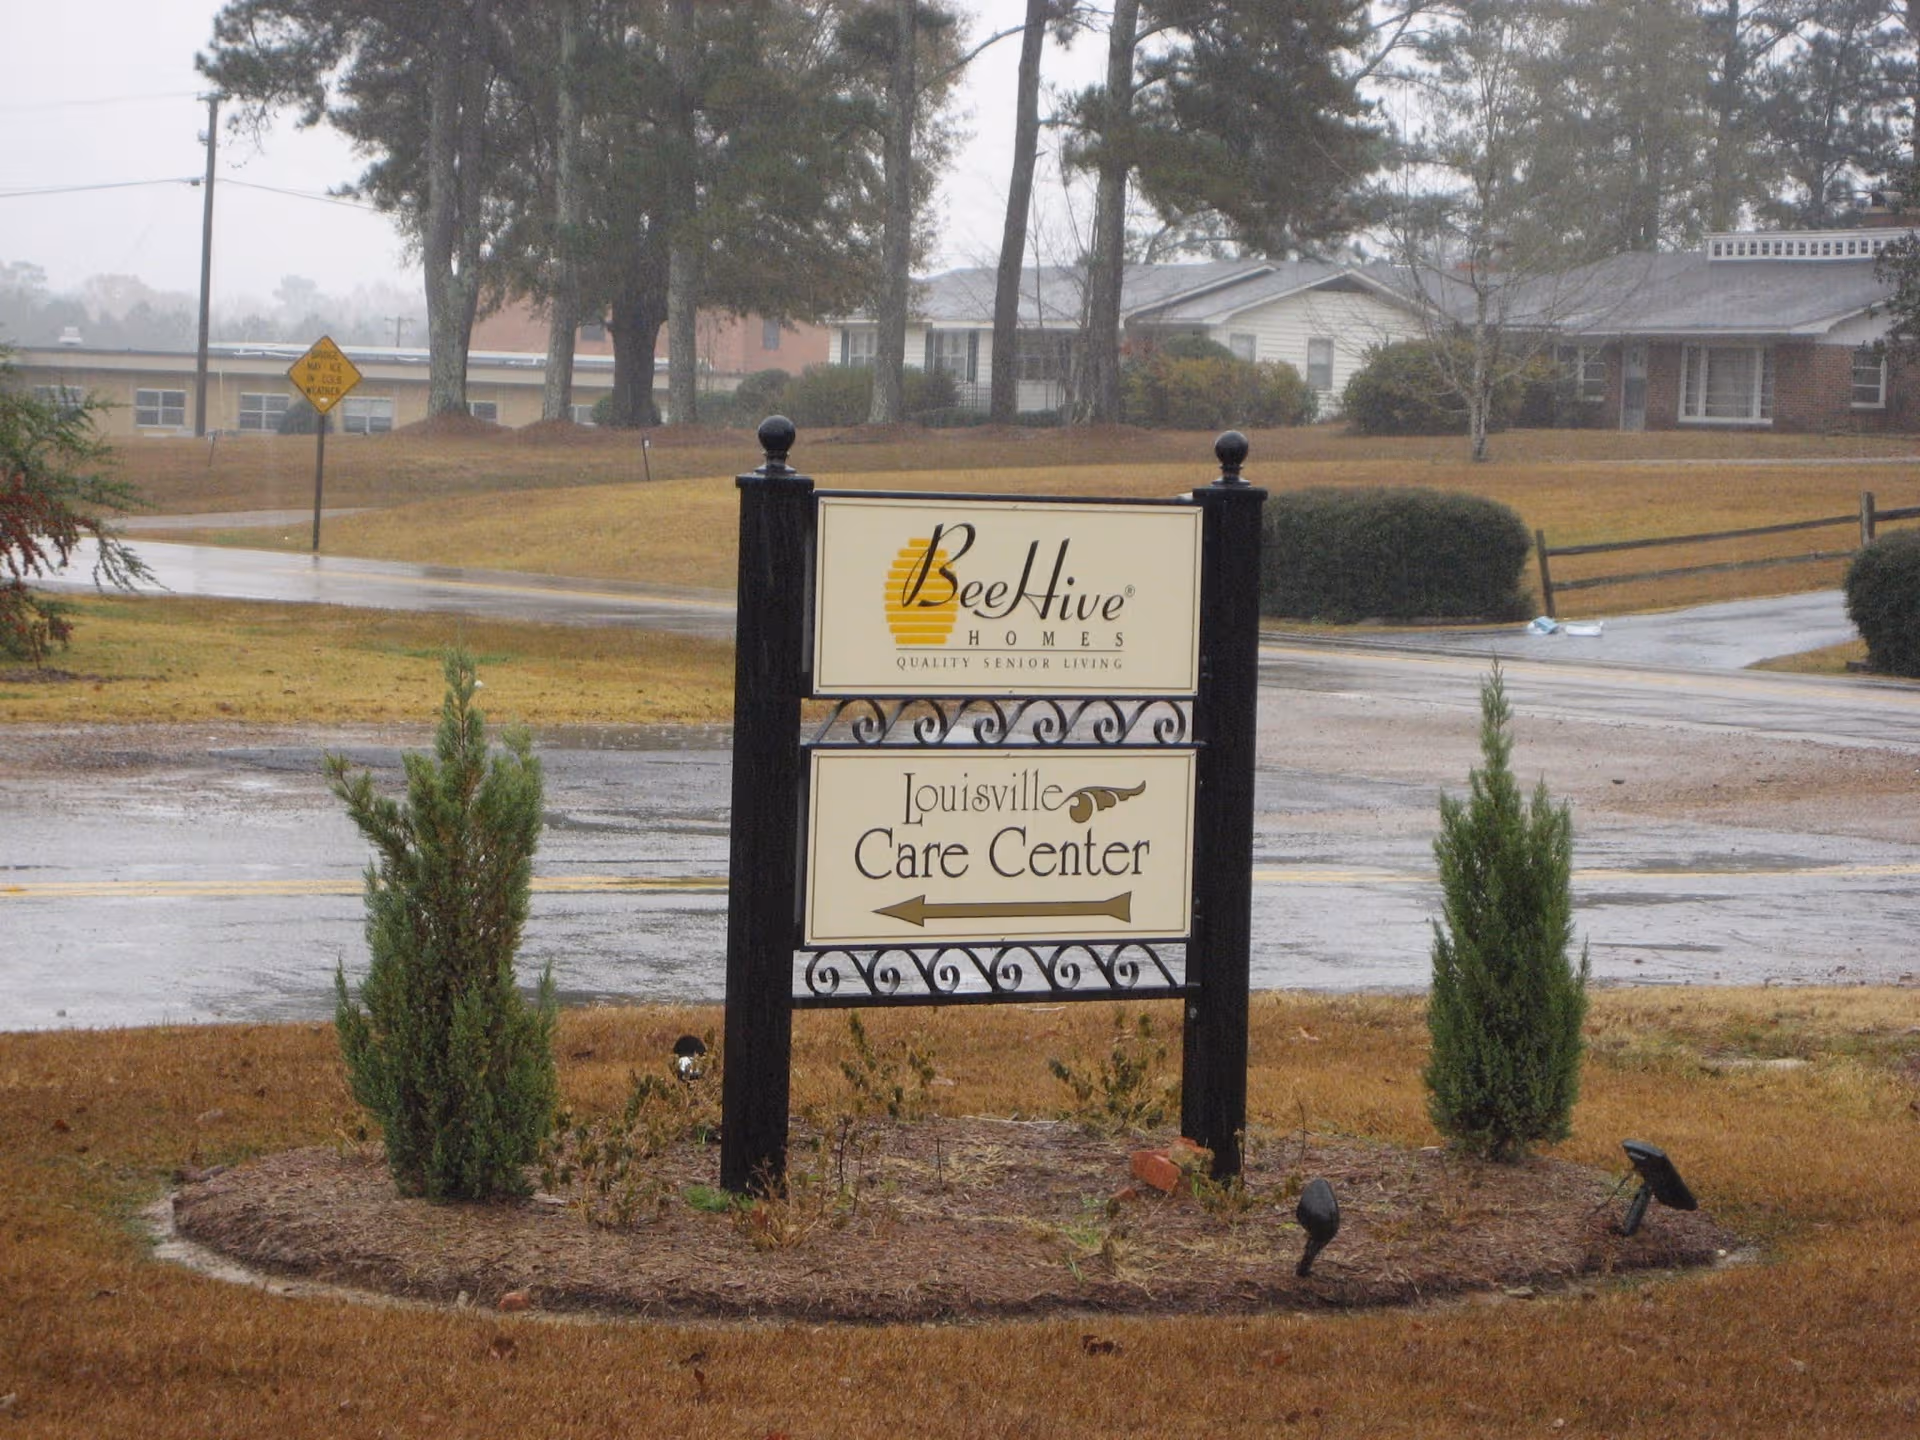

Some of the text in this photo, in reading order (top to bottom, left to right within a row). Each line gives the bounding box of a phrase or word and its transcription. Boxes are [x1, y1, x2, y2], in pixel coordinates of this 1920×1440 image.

[968, 630, 1125, 647] HOMES
[896, 656, 1123, 671] QUALITY SENIOR LIVING
[902, 769, 1065, 826] Louisville
[854, 826, 1151, 880] Care Center
